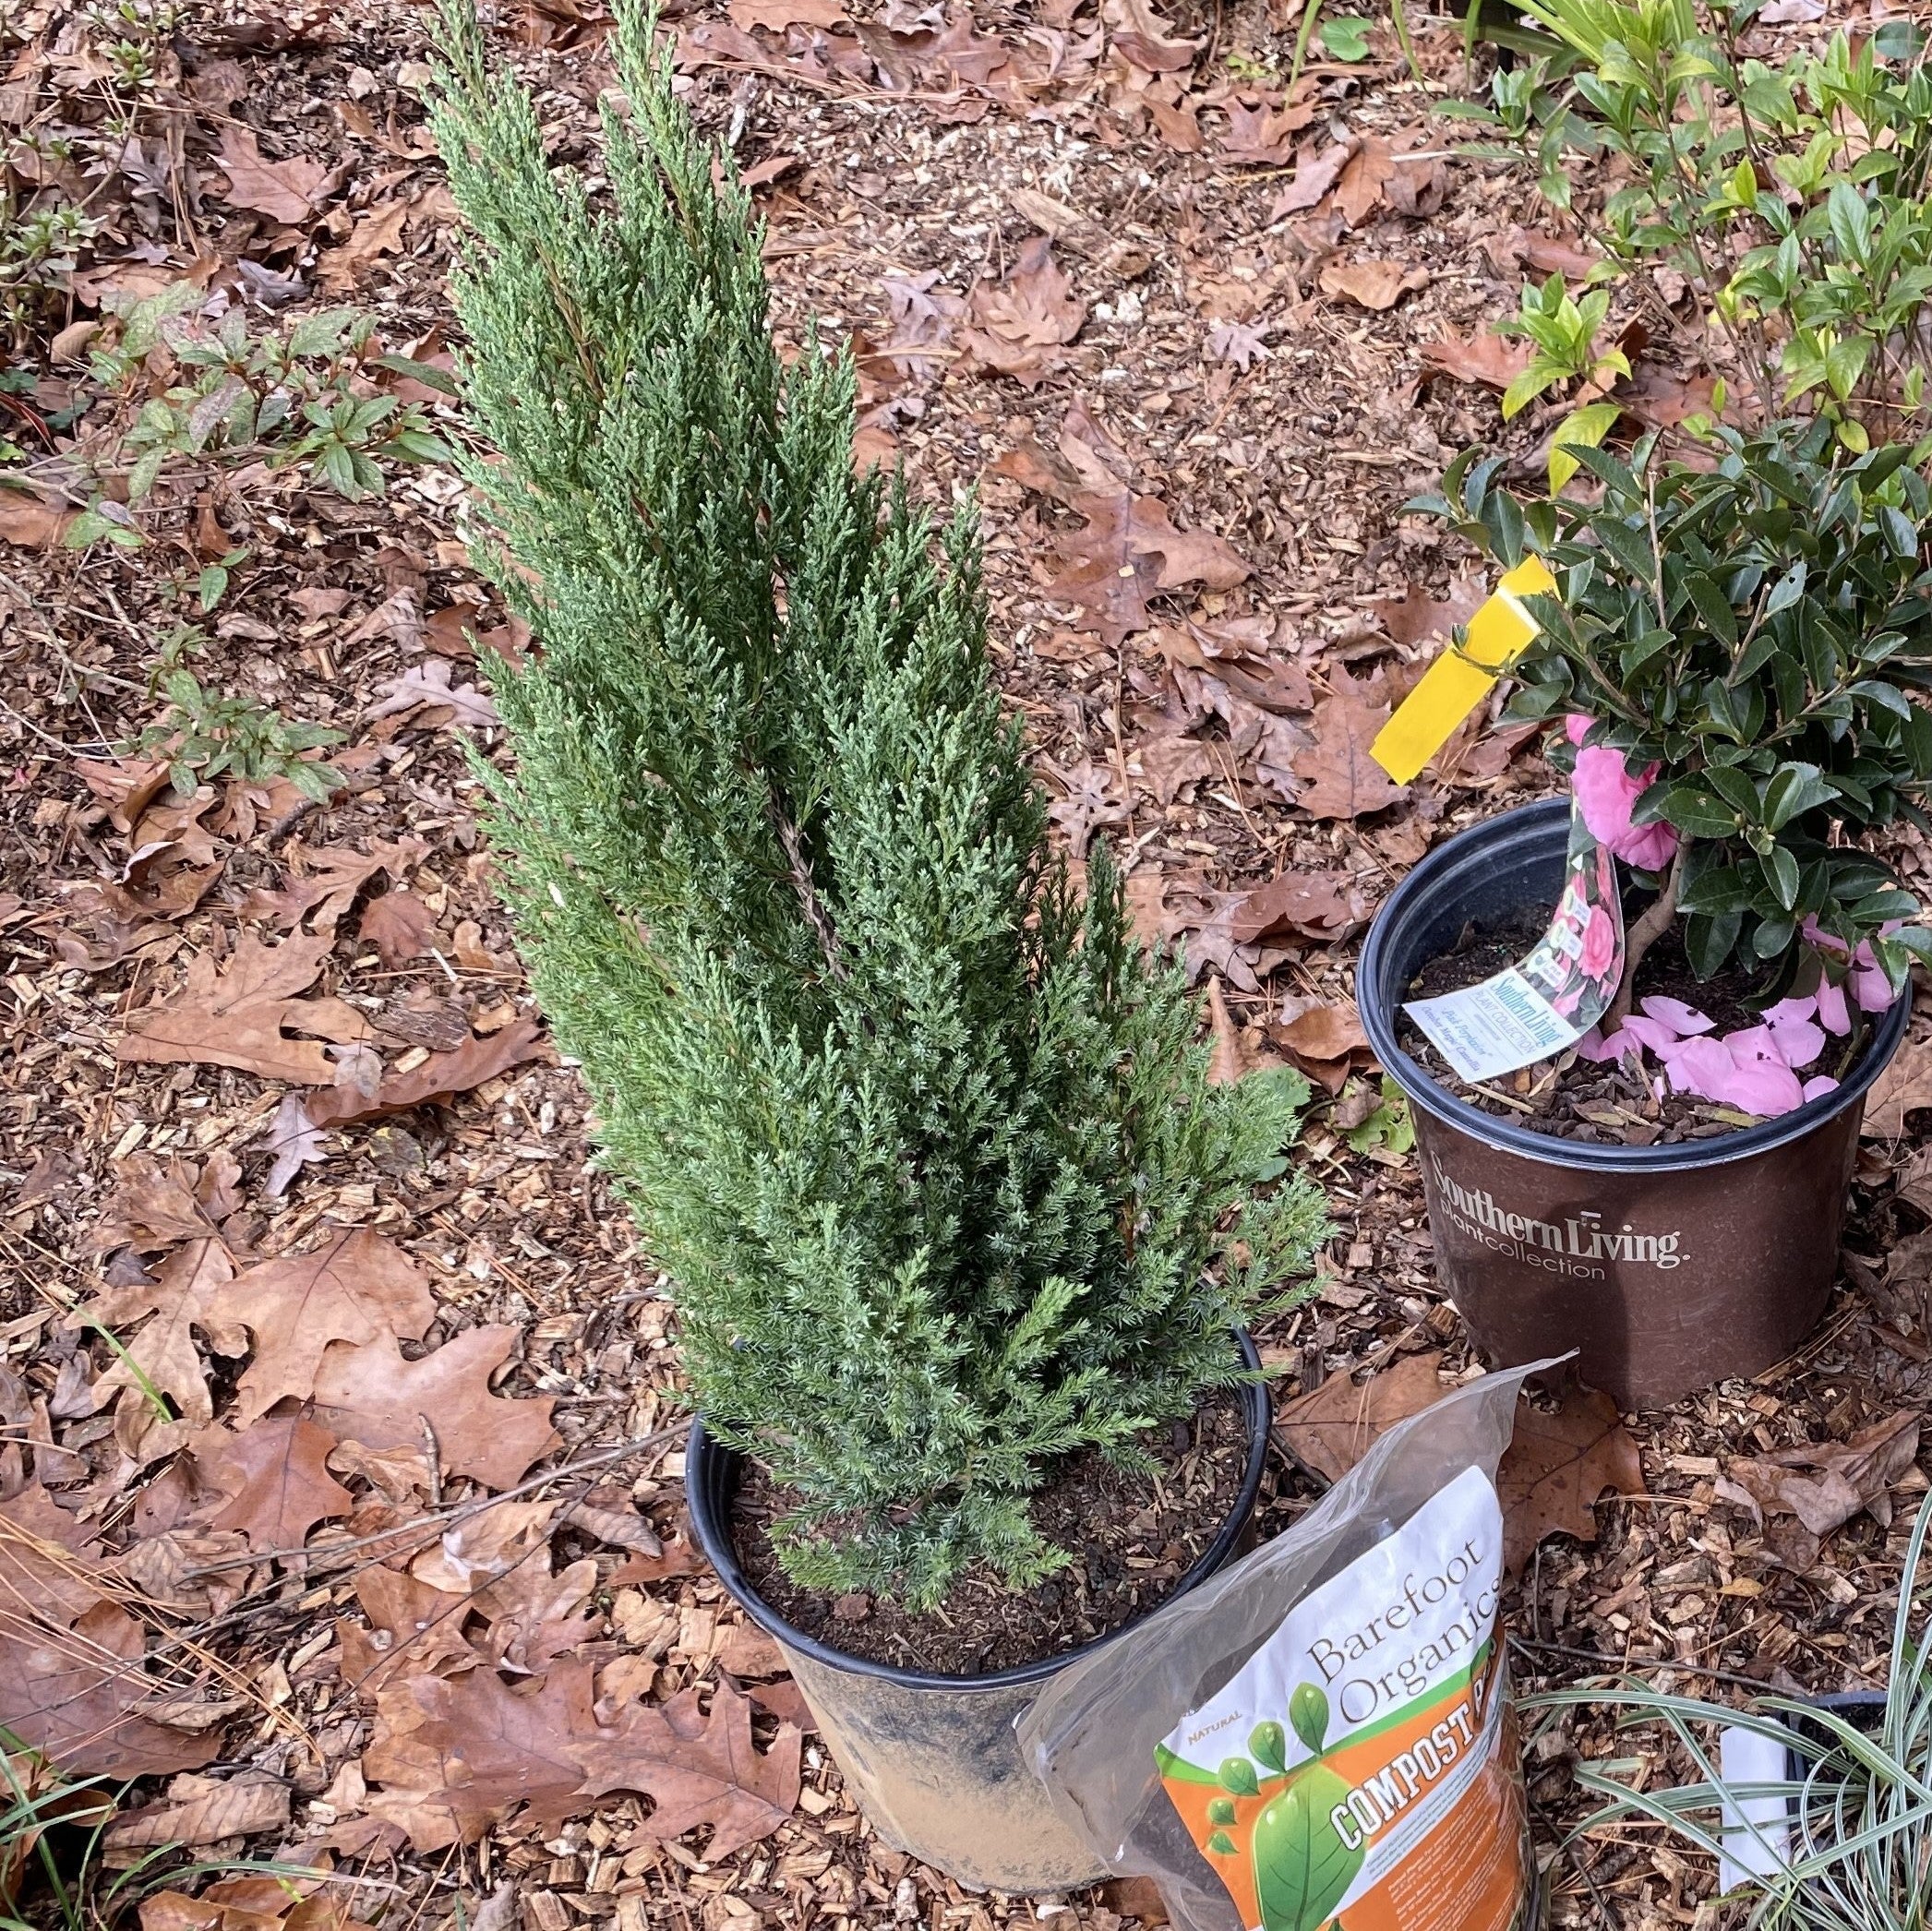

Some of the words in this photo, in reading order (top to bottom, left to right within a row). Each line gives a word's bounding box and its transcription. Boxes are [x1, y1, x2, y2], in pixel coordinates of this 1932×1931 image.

[1306, 1537, 1484, 1685] Barefoot
[1187, 1709, 1243, 1745] NATURAL
[1329, 1704, 1472, 1852] COMPOST
